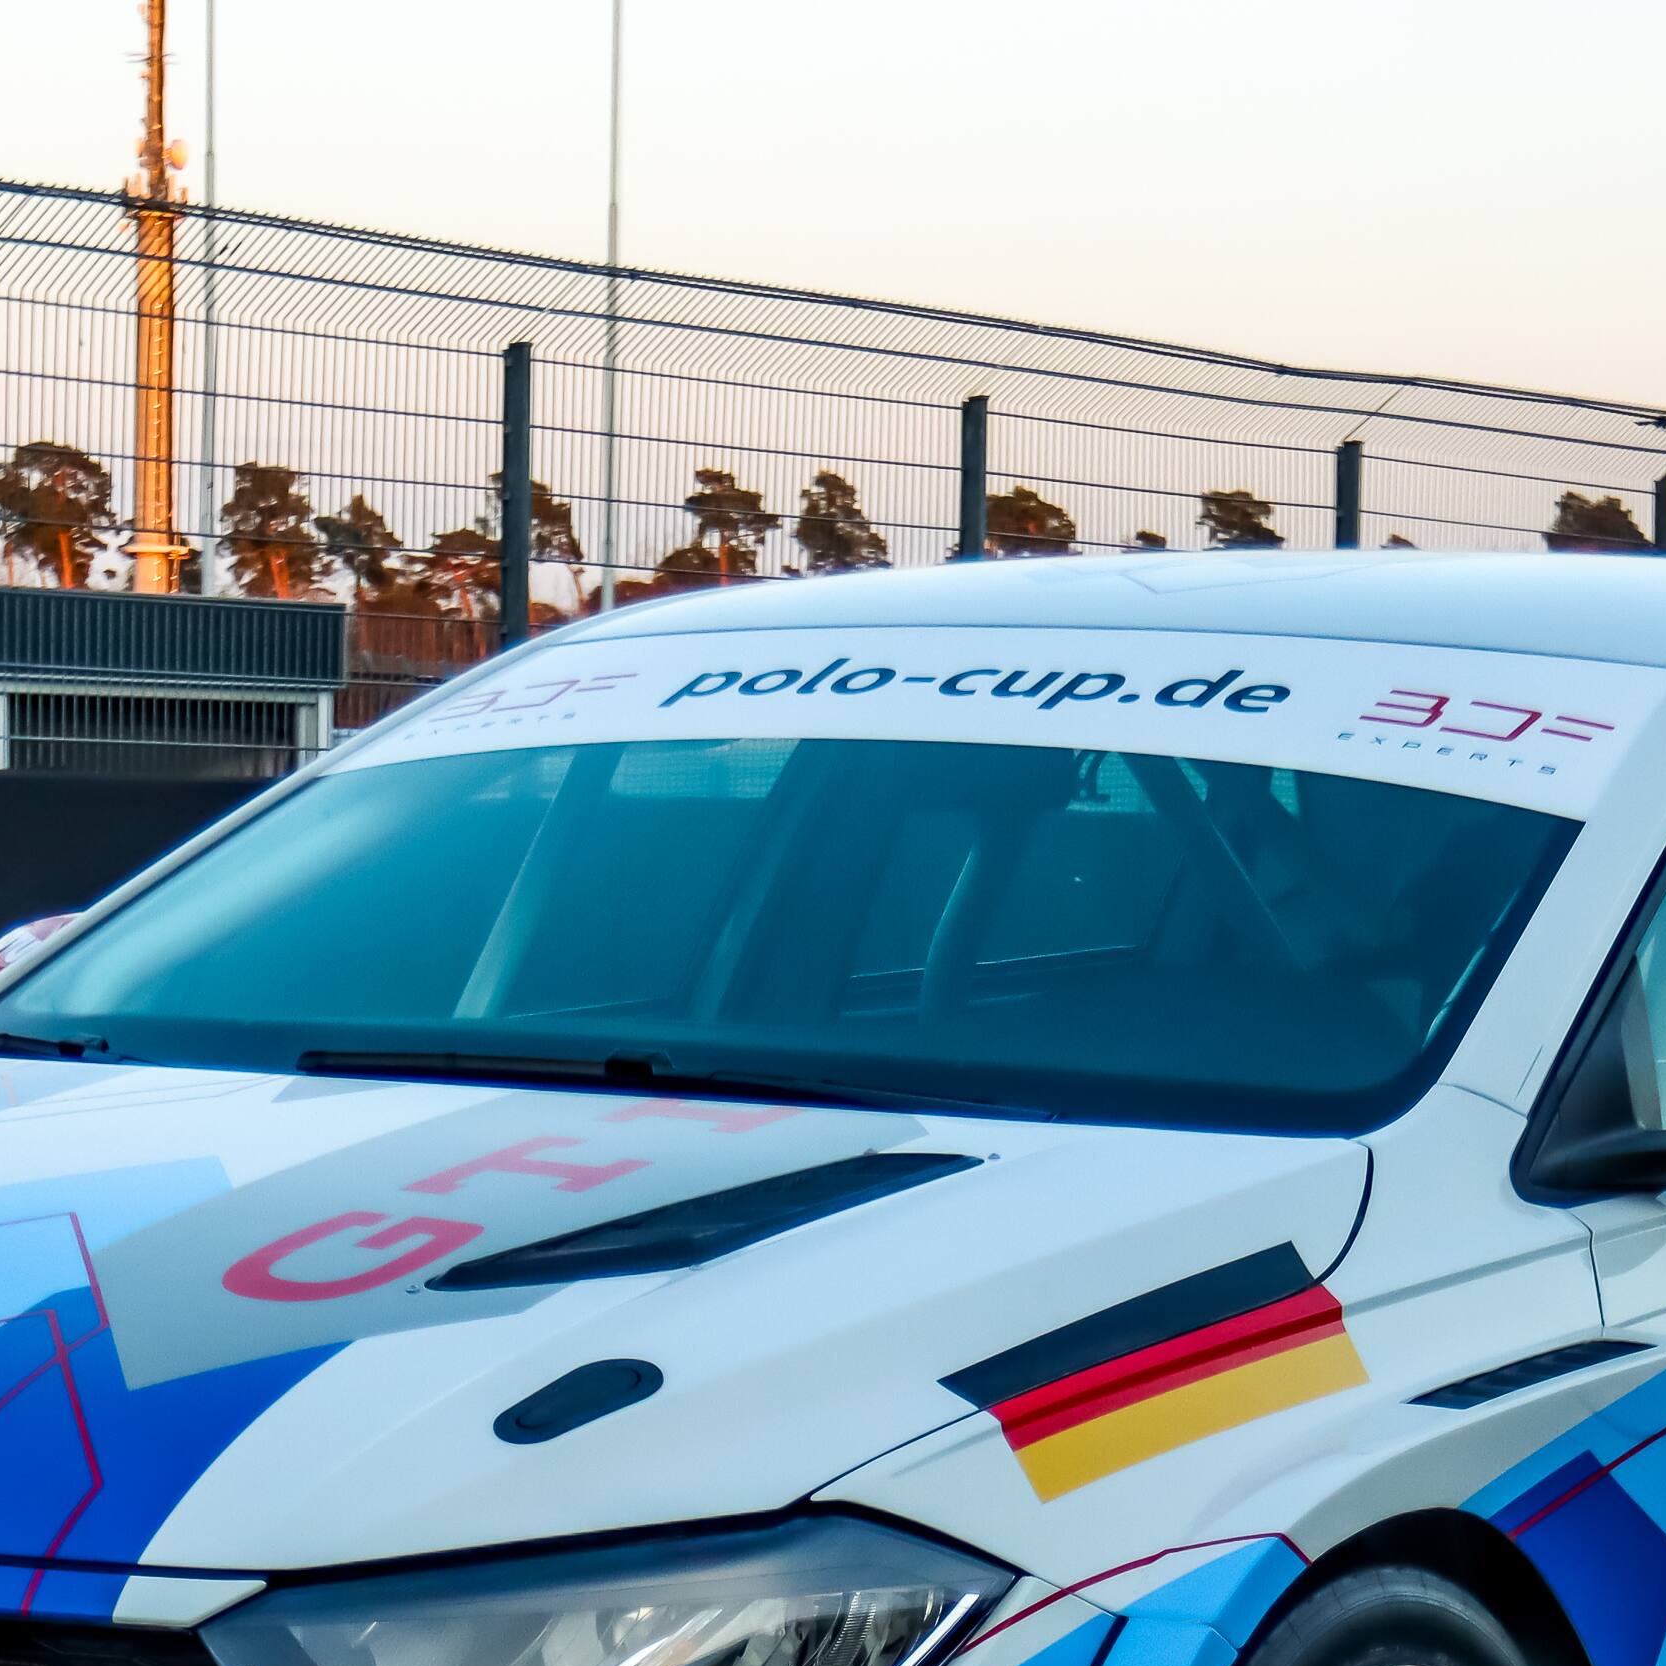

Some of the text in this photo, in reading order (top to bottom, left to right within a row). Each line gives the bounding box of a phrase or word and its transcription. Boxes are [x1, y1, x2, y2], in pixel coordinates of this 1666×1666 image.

[658, 658, 1291, 713] polo-cup.de
[403, 711, 576, 741] EXPERTS
[1337, 731, 1558, 776] EXPERTS
